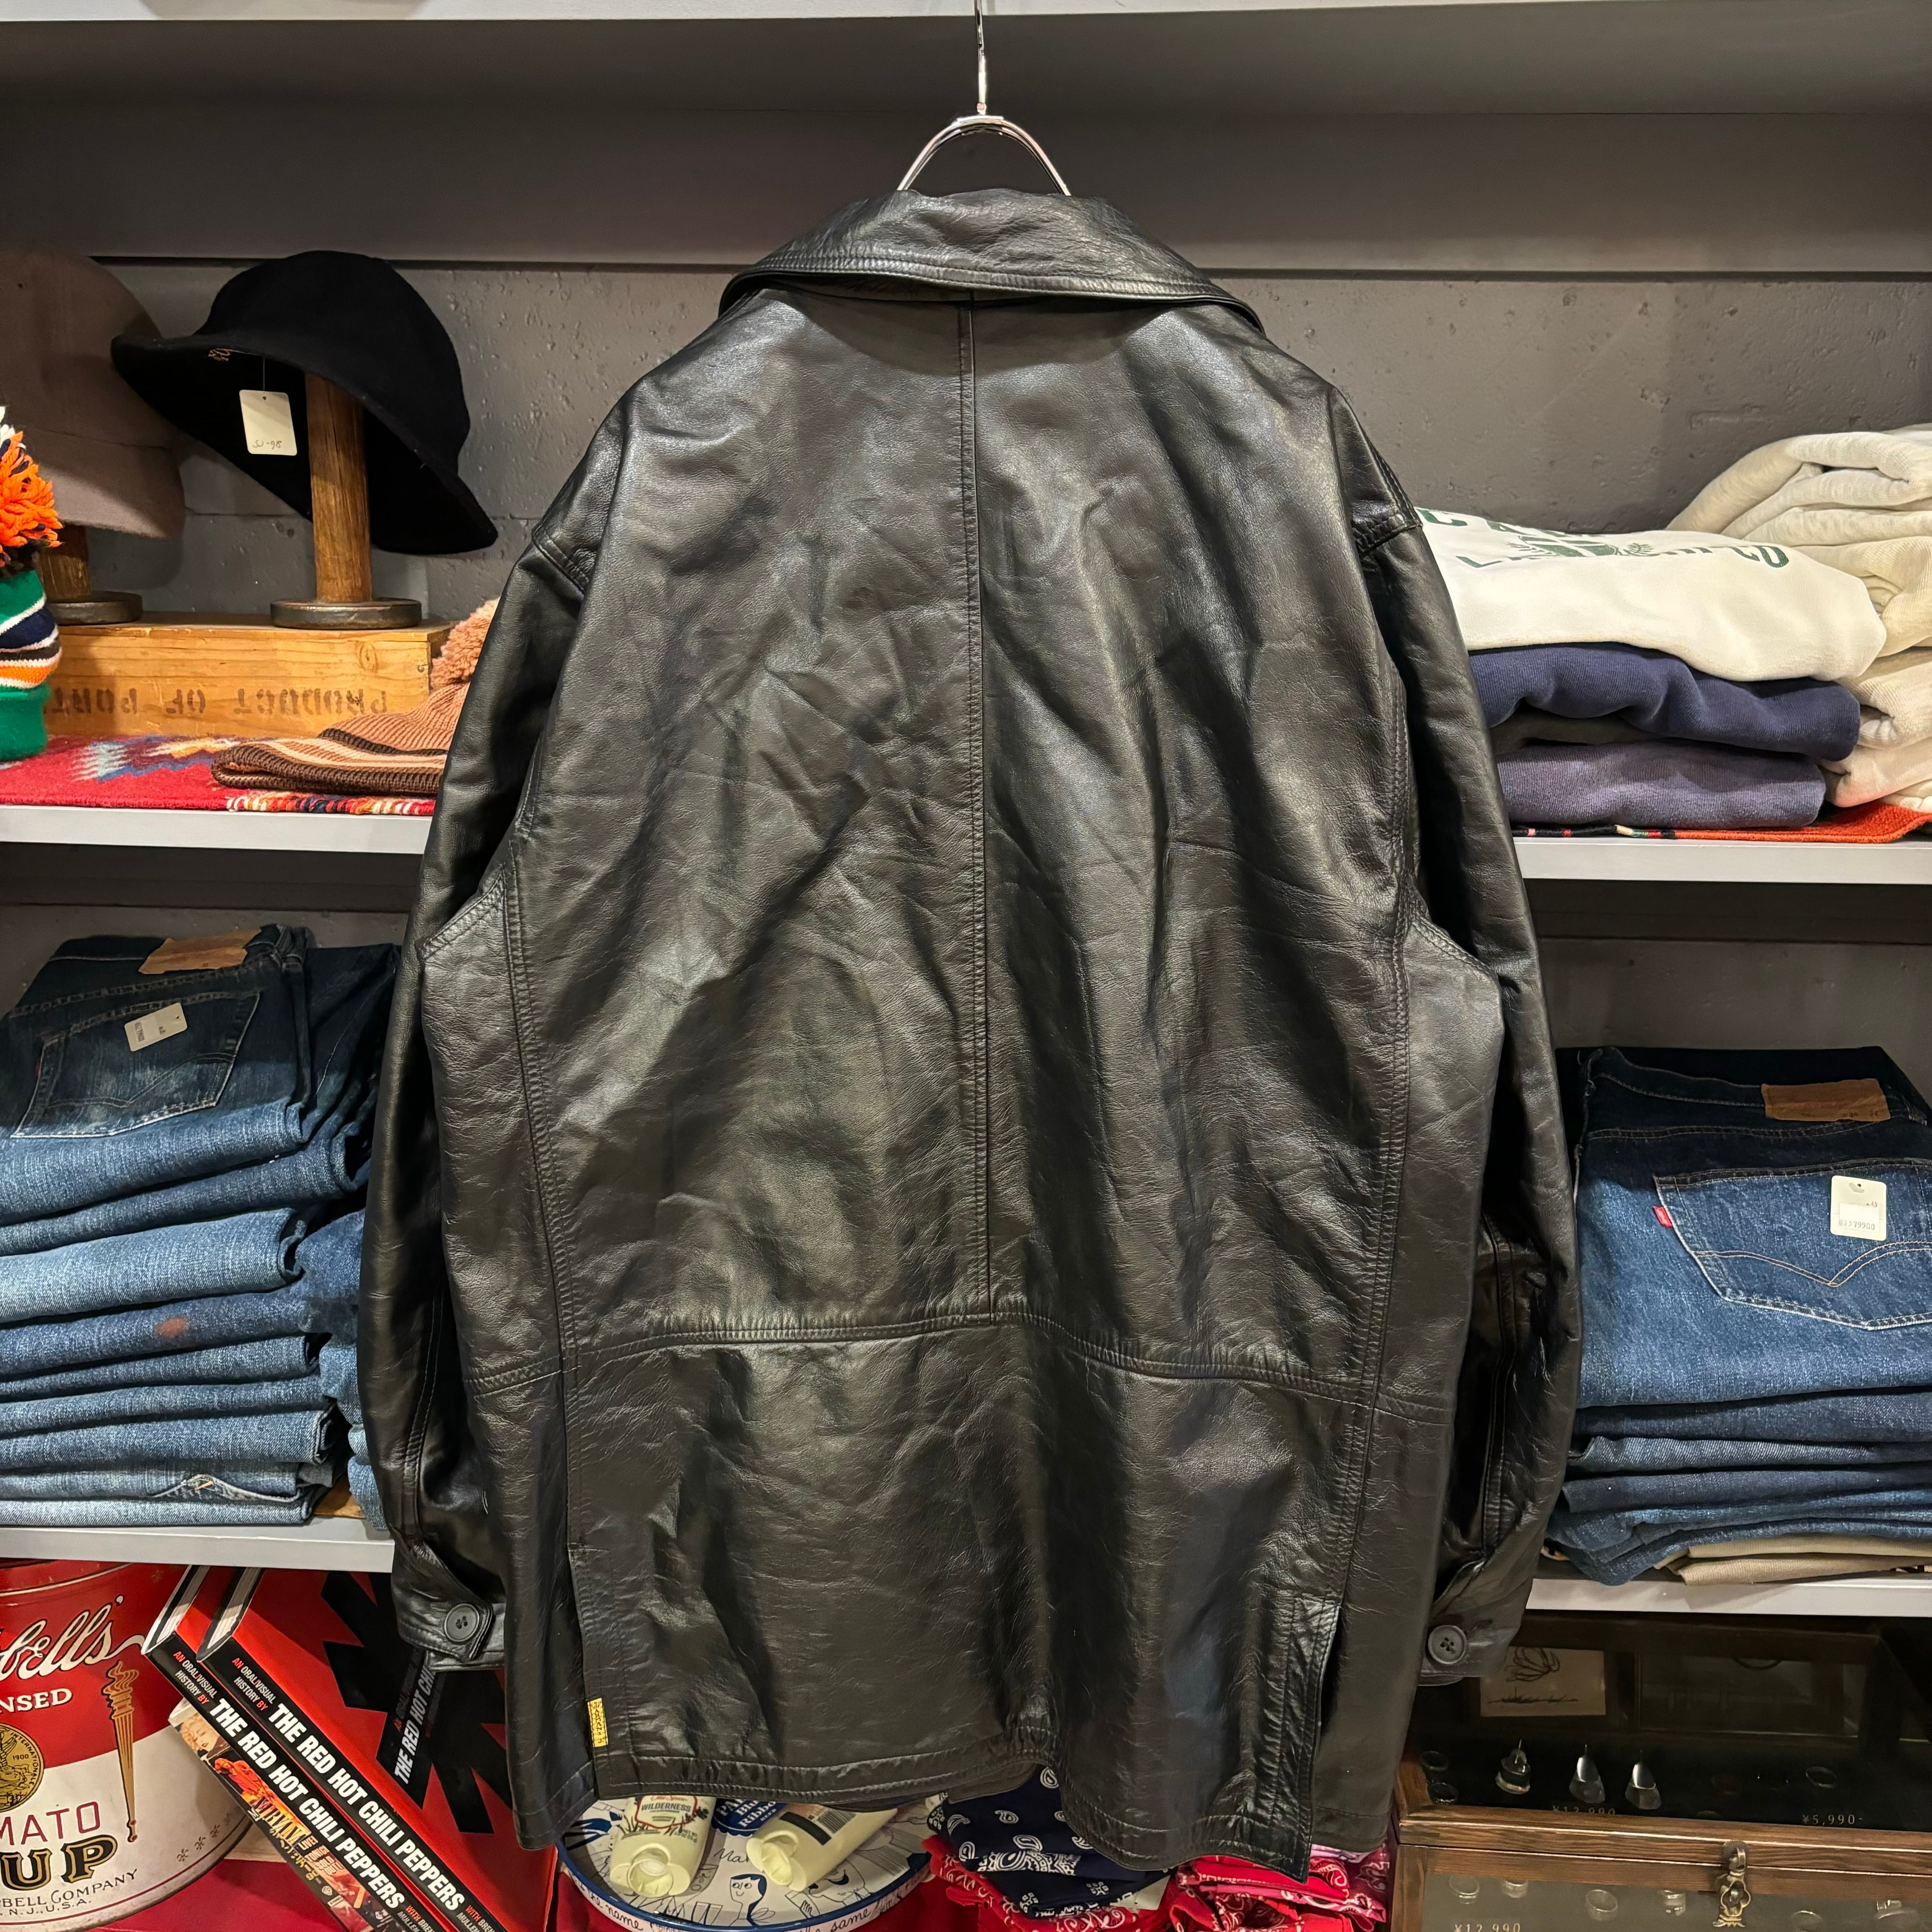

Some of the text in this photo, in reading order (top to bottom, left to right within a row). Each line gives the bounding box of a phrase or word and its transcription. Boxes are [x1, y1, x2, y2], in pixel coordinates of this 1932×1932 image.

[44, 688, 388, 715] PRODUCT OF PORT
[0, 1595, 144, 1681] bell's
[173, 1651, 185, 1663] AN
[232, 1657, 244, 1669] AN
[175, 1670, 209, 1705] HISTORY BY
[234, 1676, 268, 1711] HISTORY BY
[418, 1665, 436, 1696] CHI
[410, 1689, 428, 1725] HOT
[402, 1720, 419, 1756] RED
[394, 1748, 414, 1785] THE
[209, 1698, 248, 1737] THE
[238, 1730, 277, 1769] RED
[268, 1764, 308, 1801] HOT
[299, 1798, 345, 1842] CHILI
[335, 1837, 405, 1909] PEPPERS
[268, 1702, 465, 1912] THE RED HOT CHILI PEPPERS
[641, 1802, 692, 1812] WILDERNESS
[0, 1868, 138, 1908] BELL COMPANY
[605, 1904, 644, 1931] name
[830, 1908, 871, 1932] same
